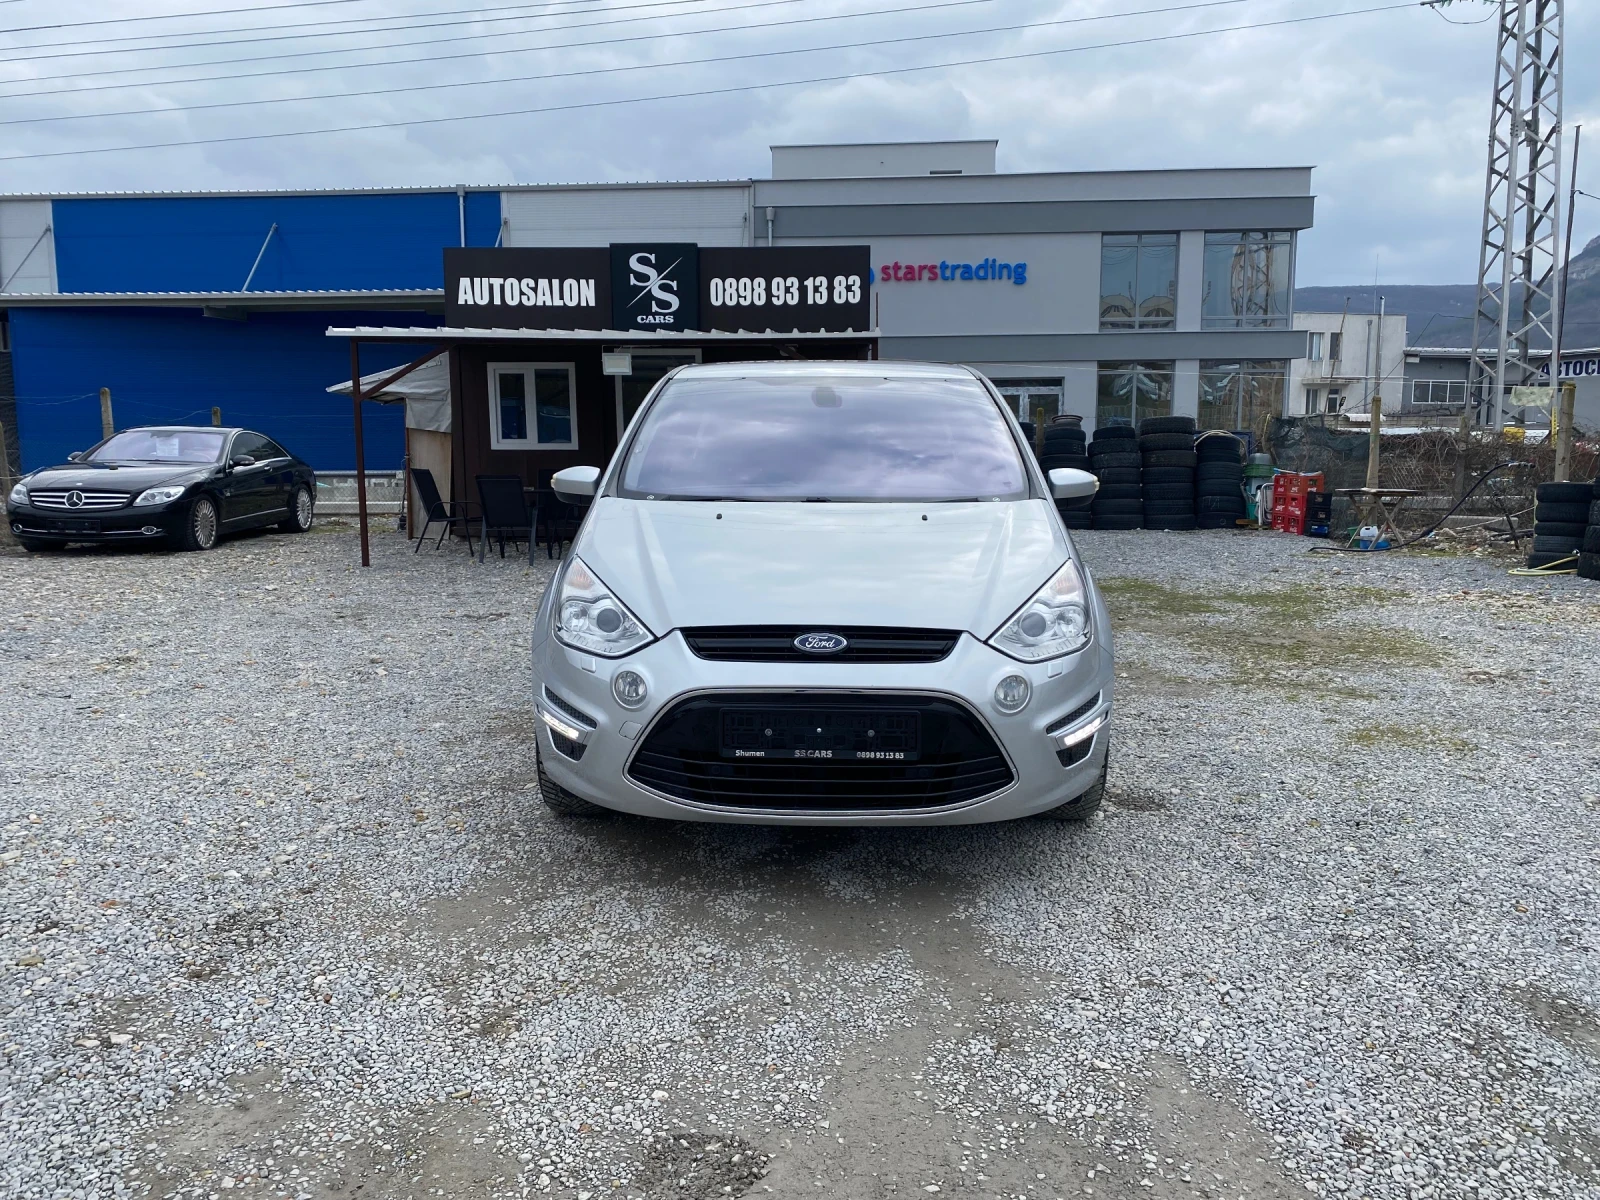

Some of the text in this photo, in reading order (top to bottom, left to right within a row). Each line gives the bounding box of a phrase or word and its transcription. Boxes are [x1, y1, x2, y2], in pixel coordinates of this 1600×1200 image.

[457, 277, 597, 307] AUTOSALON
[709, 275, 861, 306] 0898 93 13 83
[636, 314, 675, 325] CARS
[805, 635, 836, 648] Ford
[735, 749, 765, 758] Shumen
[856, 751, 875, 760] 0898
